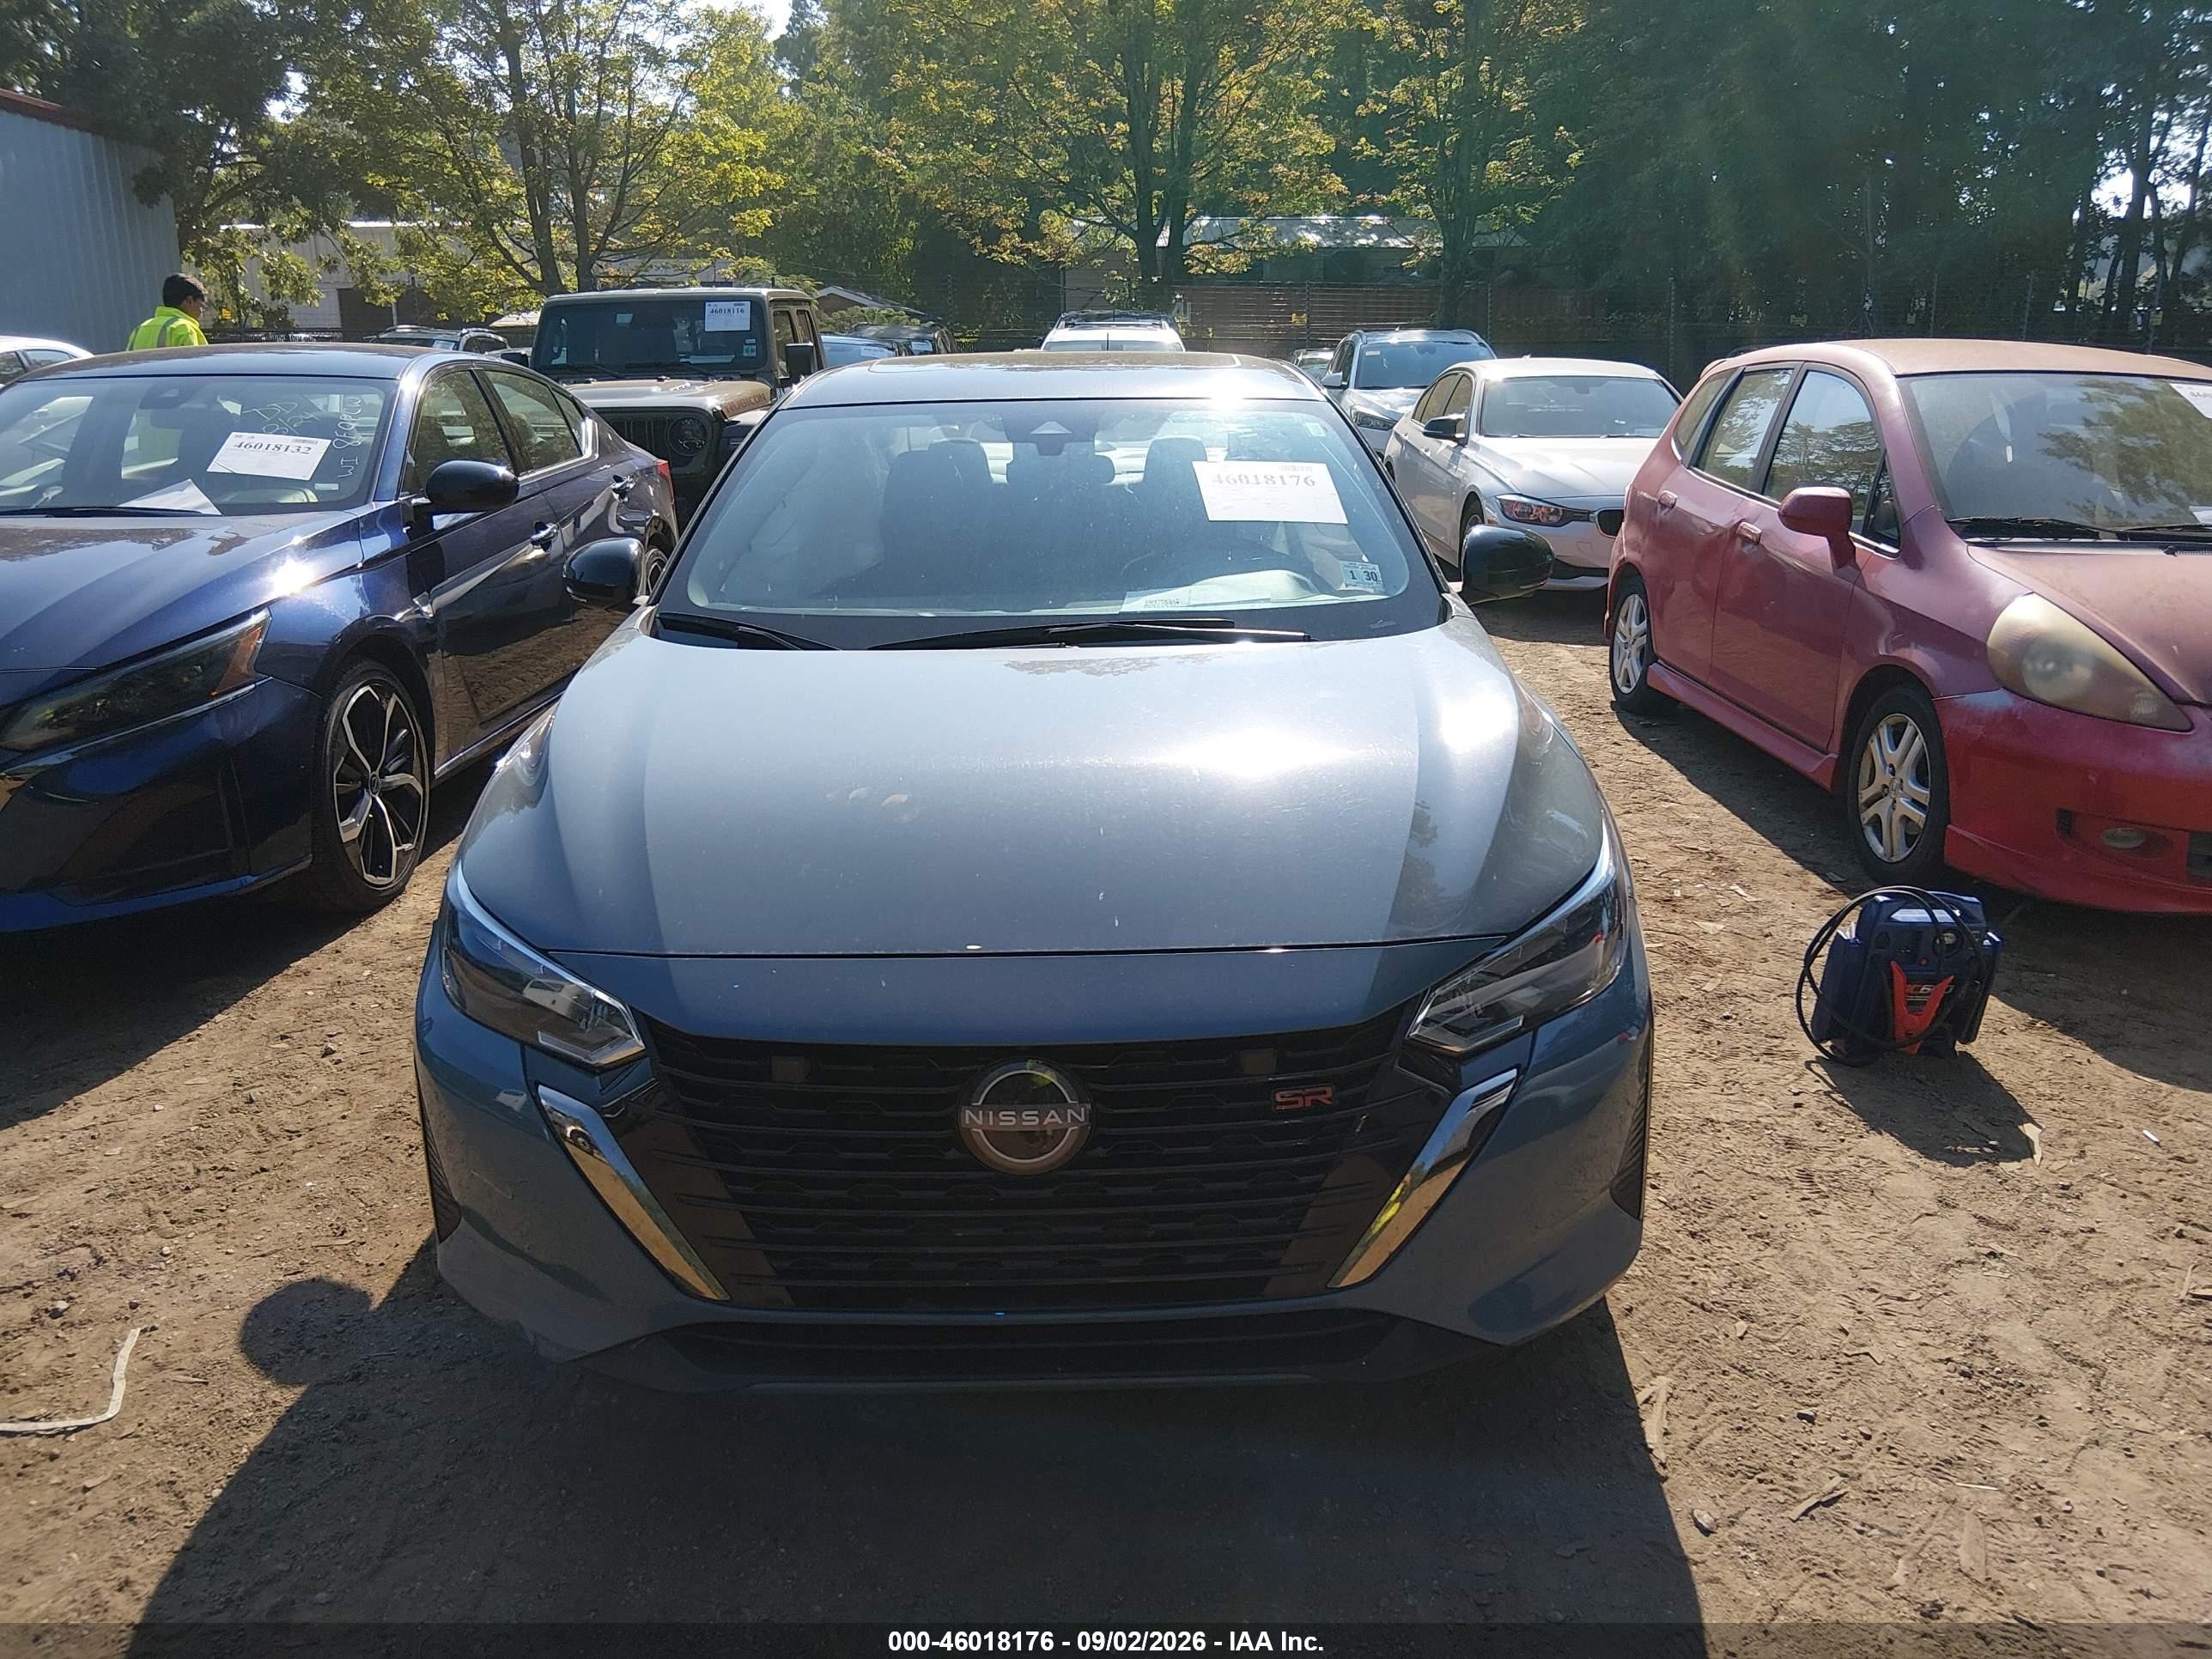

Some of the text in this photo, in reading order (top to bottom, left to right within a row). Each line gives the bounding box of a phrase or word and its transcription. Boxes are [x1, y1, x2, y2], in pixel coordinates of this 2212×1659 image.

[234, 441, 312, 455] 46018132
[1212, 473, 1316, 487] 46018176
[1349, 570, 1377, 581] 1 30
[1275, 1085, 1333, 1110] SR
[964, 1107, 1085, 1126] NISSAN
